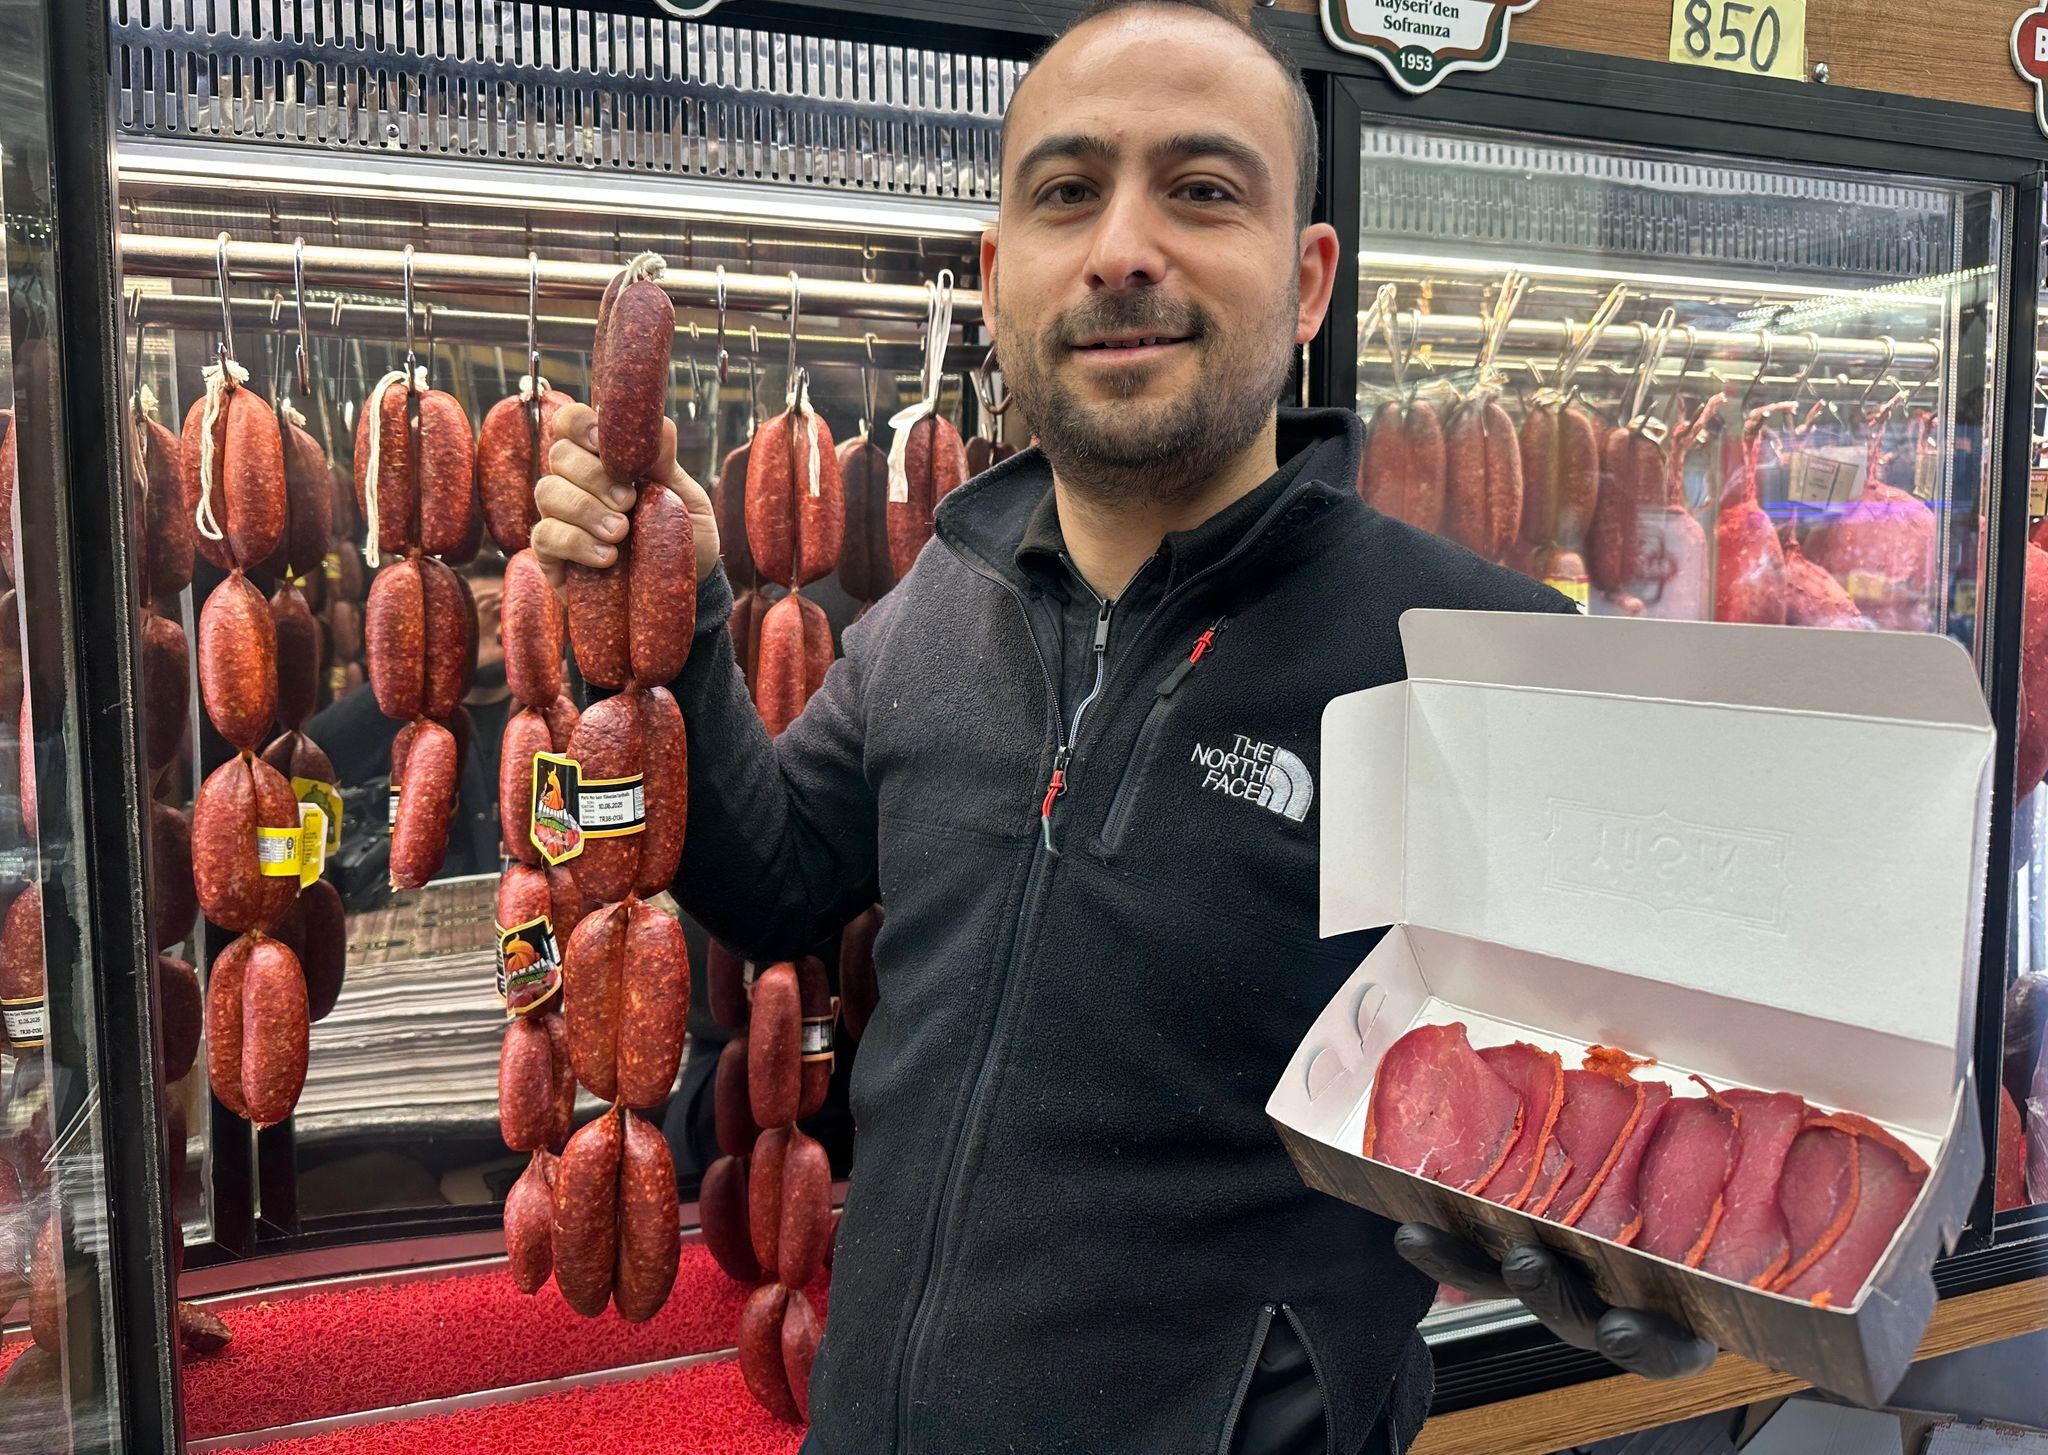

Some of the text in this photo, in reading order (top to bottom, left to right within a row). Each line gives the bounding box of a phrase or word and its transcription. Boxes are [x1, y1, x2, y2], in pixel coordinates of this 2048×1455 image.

[1383, 14, 1451, 38] Sofranıza
[1684, 0, 1781, 72] 850
[1400, 52, 1433, 72] 1953
[1191, 742, 1268, 783] NORTH
[1233, 733, 1275, 764] THE
[1202, 769, 1263, 801] FACE
